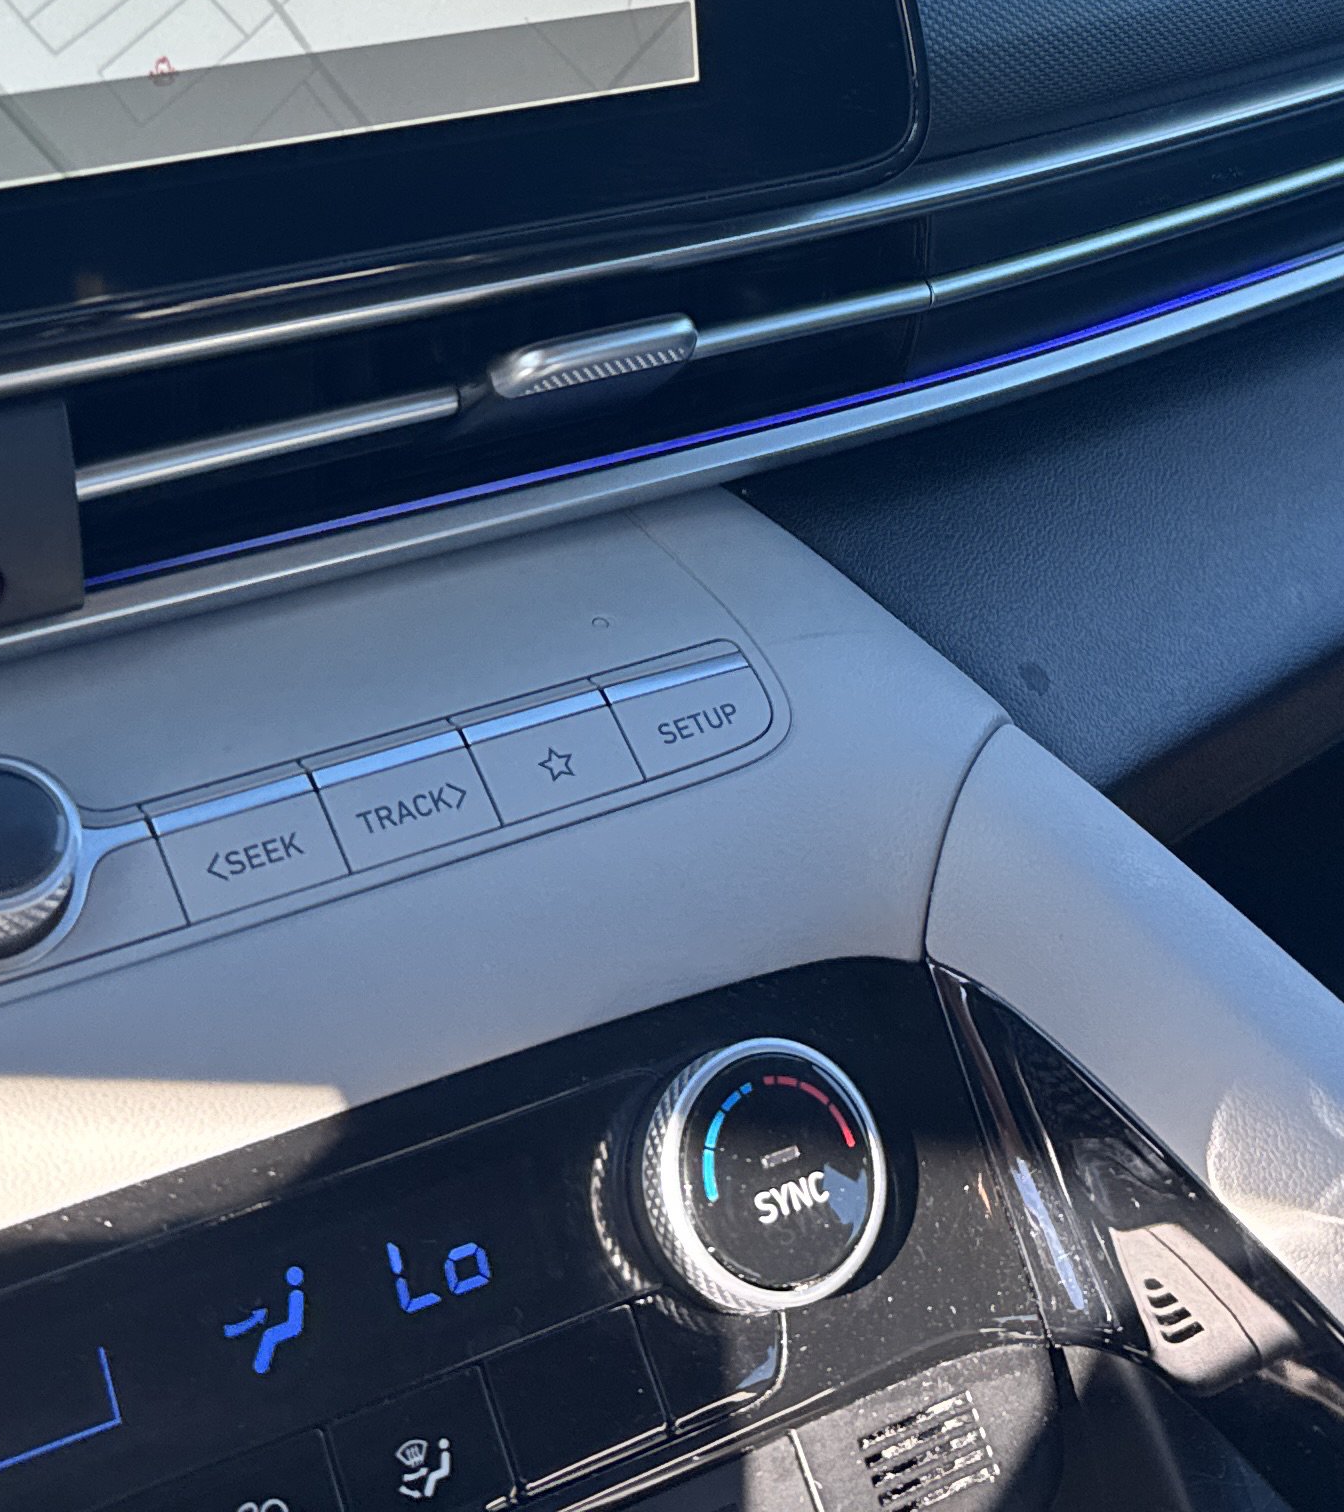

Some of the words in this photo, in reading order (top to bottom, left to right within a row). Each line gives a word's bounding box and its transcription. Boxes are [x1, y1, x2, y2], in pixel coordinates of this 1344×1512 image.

[657, 702, 739, 746] SETUP
[753, 1170, 831, 1225] SYNC
[386, 1242, 492, 1313] Lo
